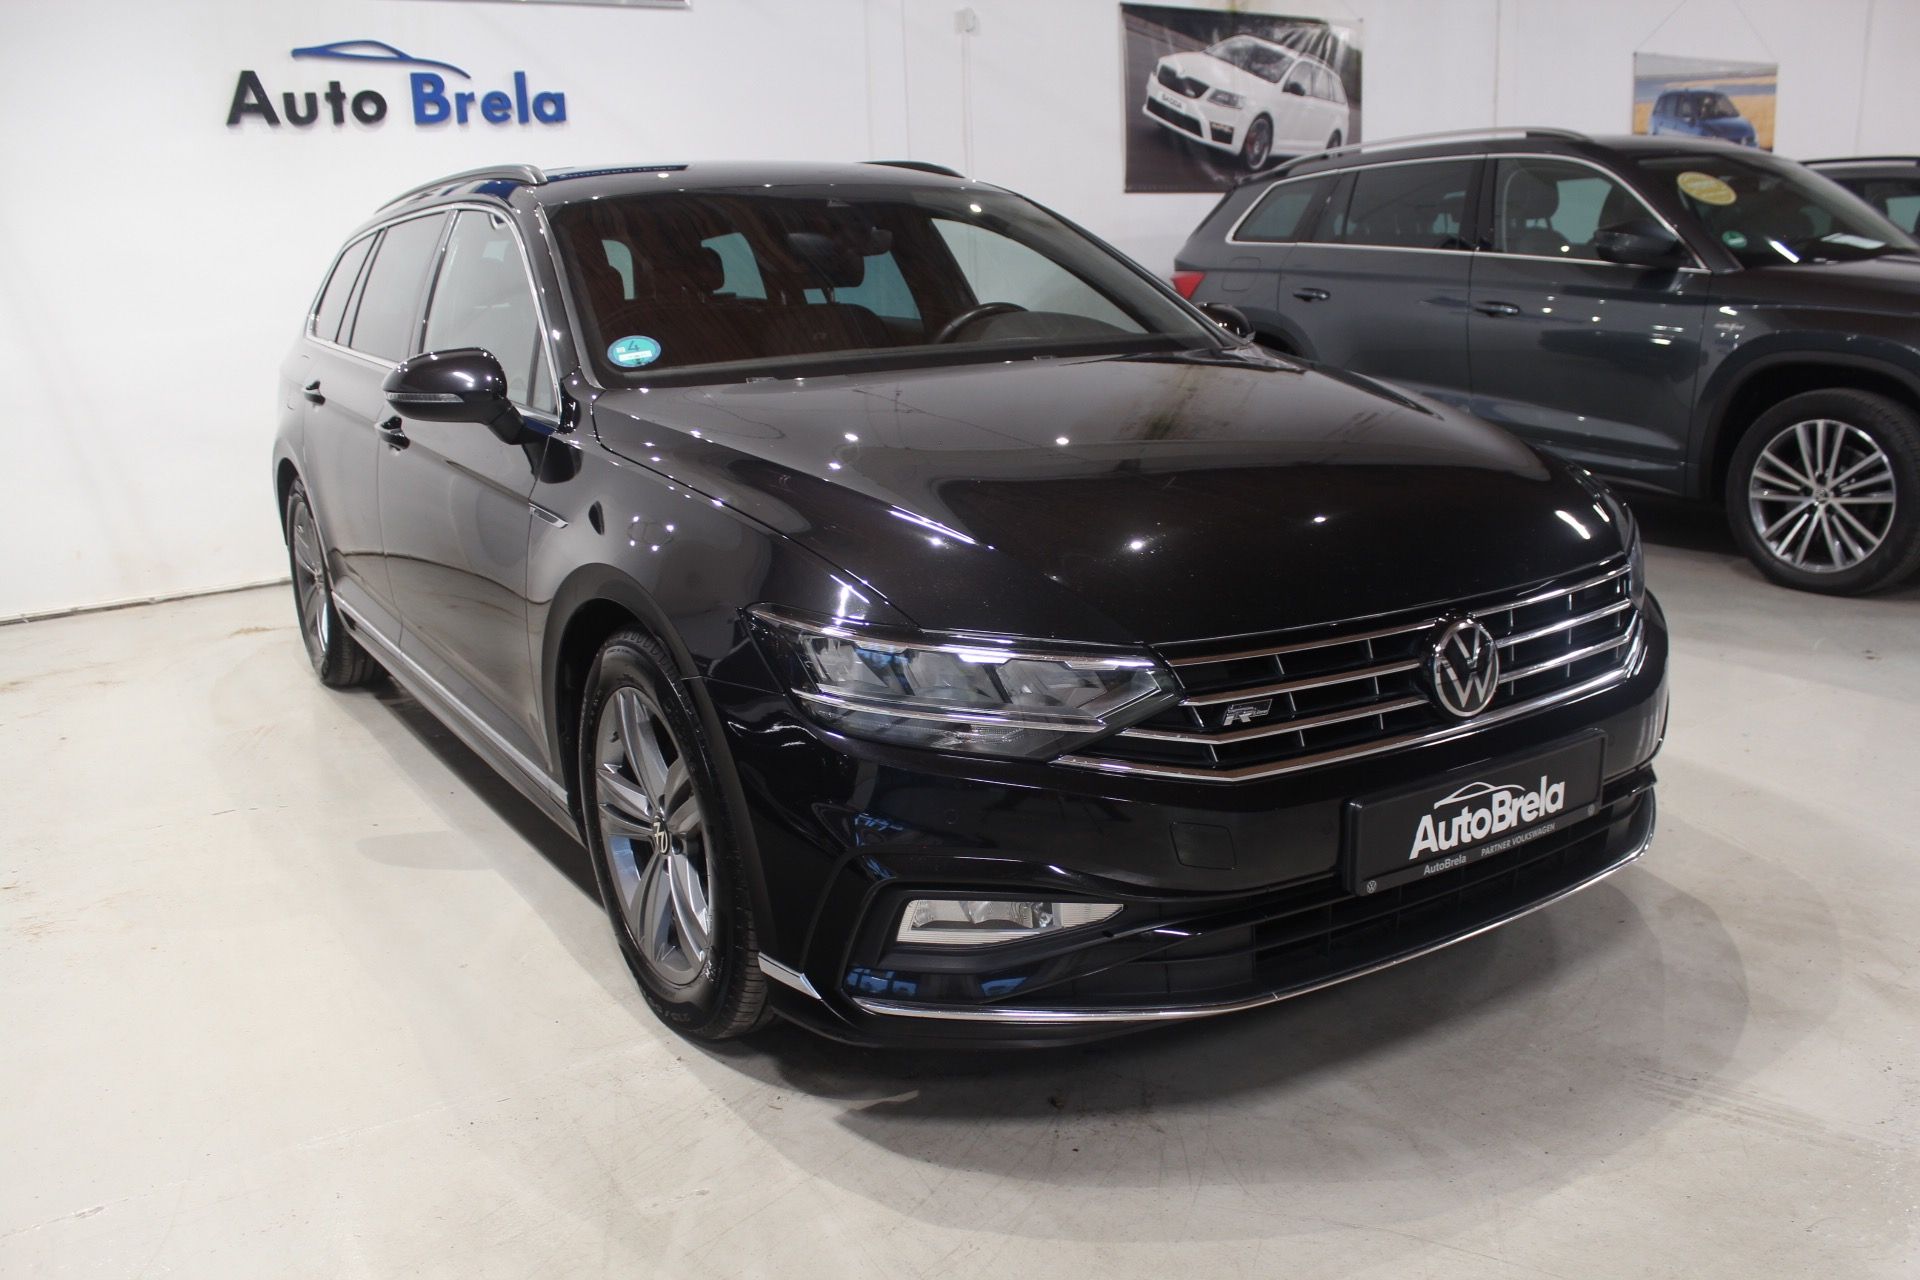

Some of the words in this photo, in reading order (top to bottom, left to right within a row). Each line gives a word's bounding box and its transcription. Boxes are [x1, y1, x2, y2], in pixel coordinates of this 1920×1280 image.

[226, 70, 388, 127] Auto
[410, 71, 567, 126] Brela
[1408, 775, 1566, 860] AutoBrela
[1480, 839, 1511, 857] PARTNER
[1511, 823, 1556, 847] VOLKSWAGEN
[1423, 854, 1467, 876] AutoBrela
